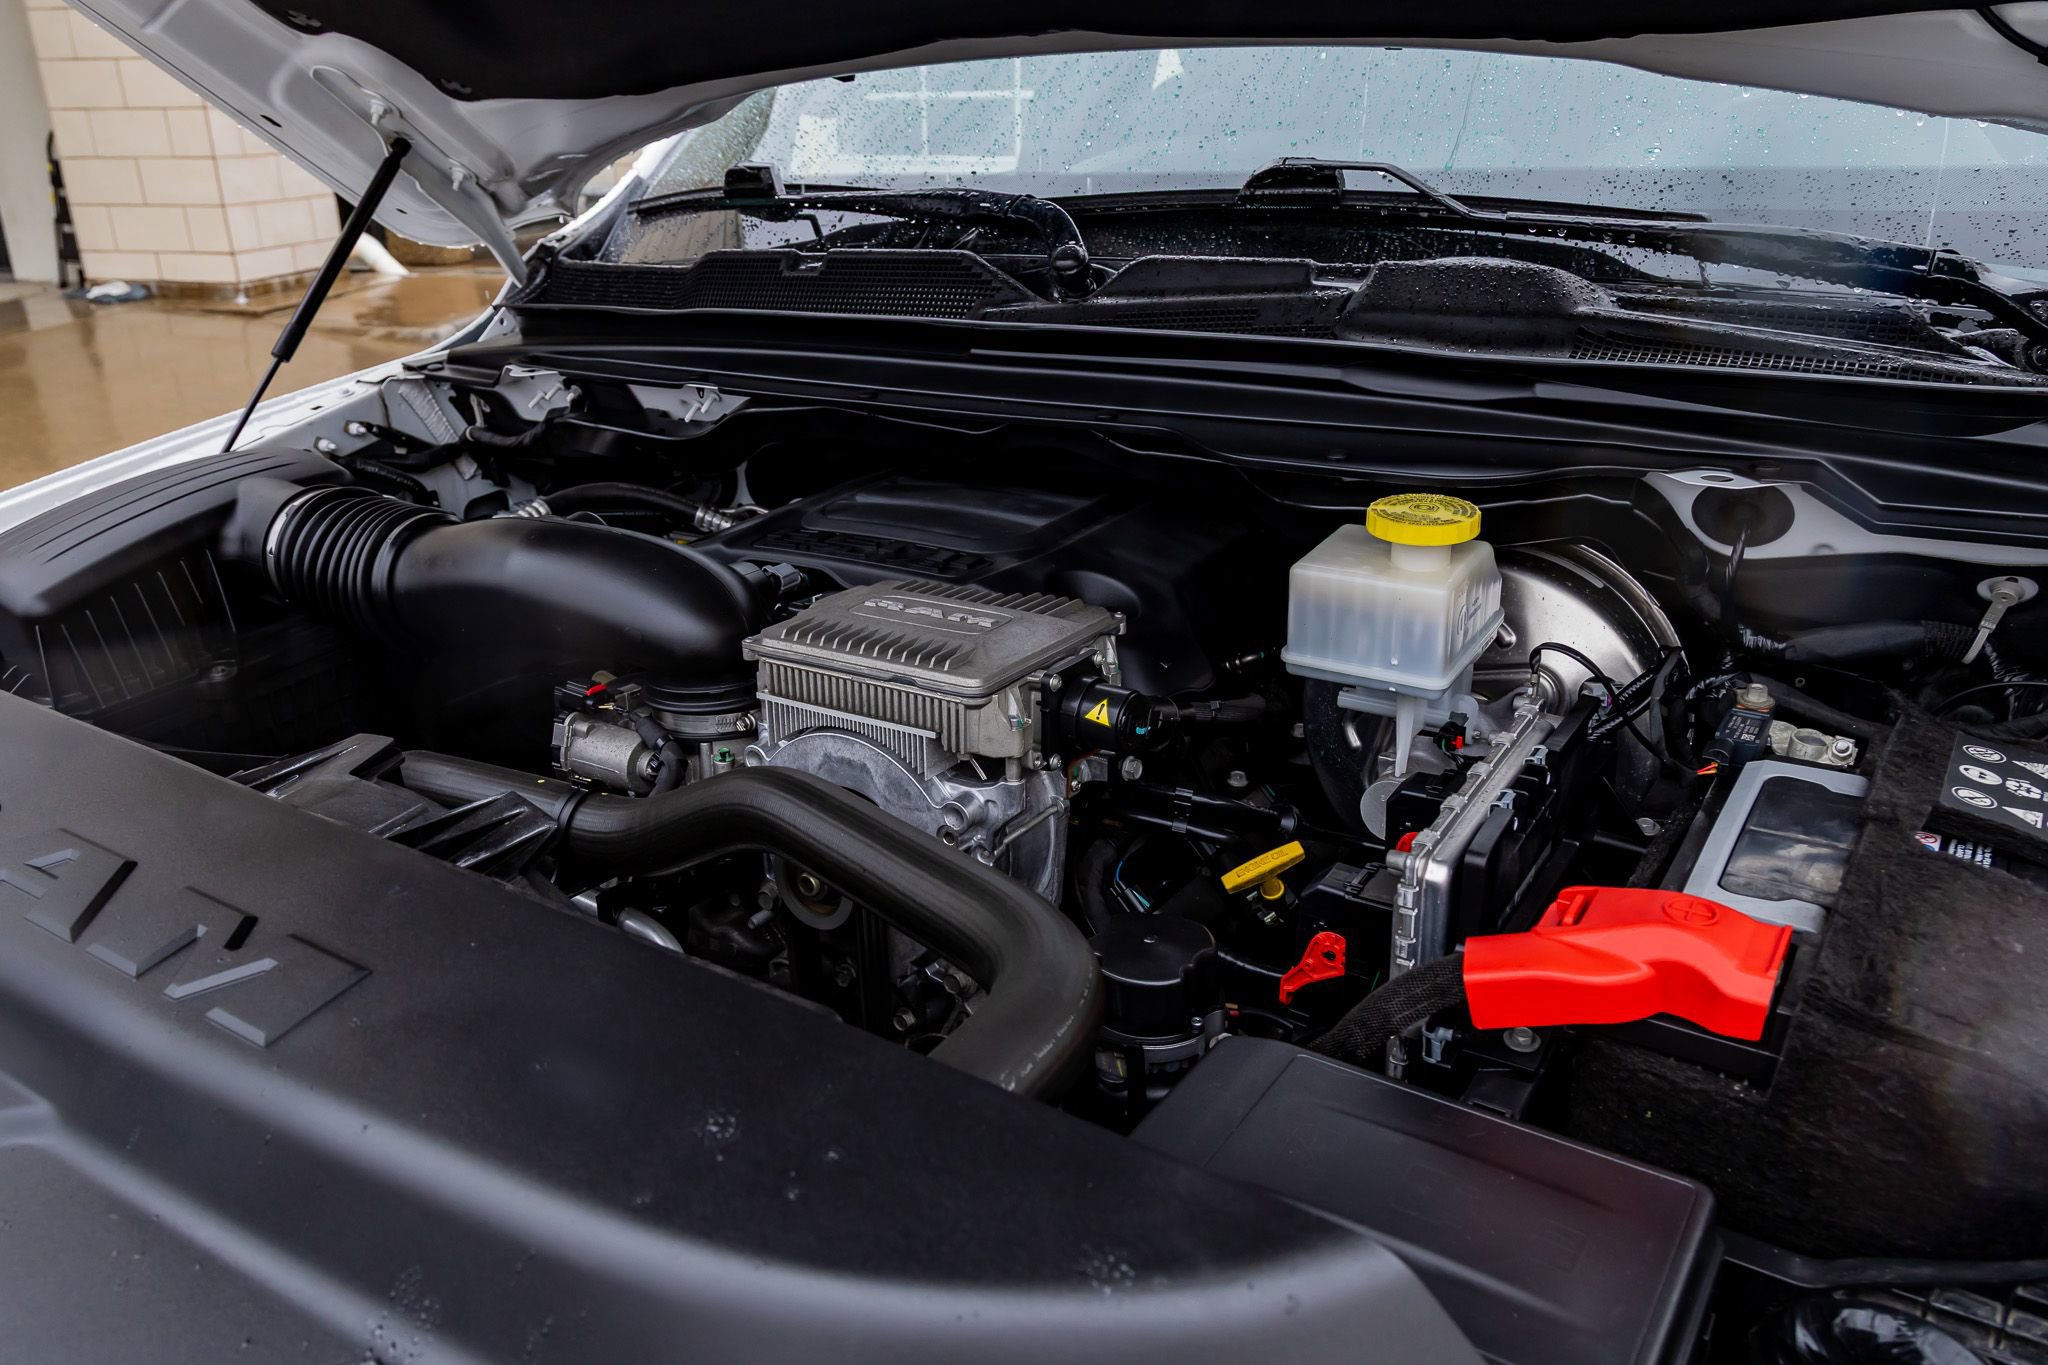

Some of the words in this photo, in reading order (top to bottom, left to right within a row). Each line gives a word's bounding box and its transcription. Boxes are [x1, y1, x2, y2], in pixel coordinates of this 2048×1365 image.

[863, 598, 998, 628] RAM
[1235, 855, 1272, 879] ENGINE
[1270, 849, 1289, 861] OIL
[0, 824, 373, 1048] AM
